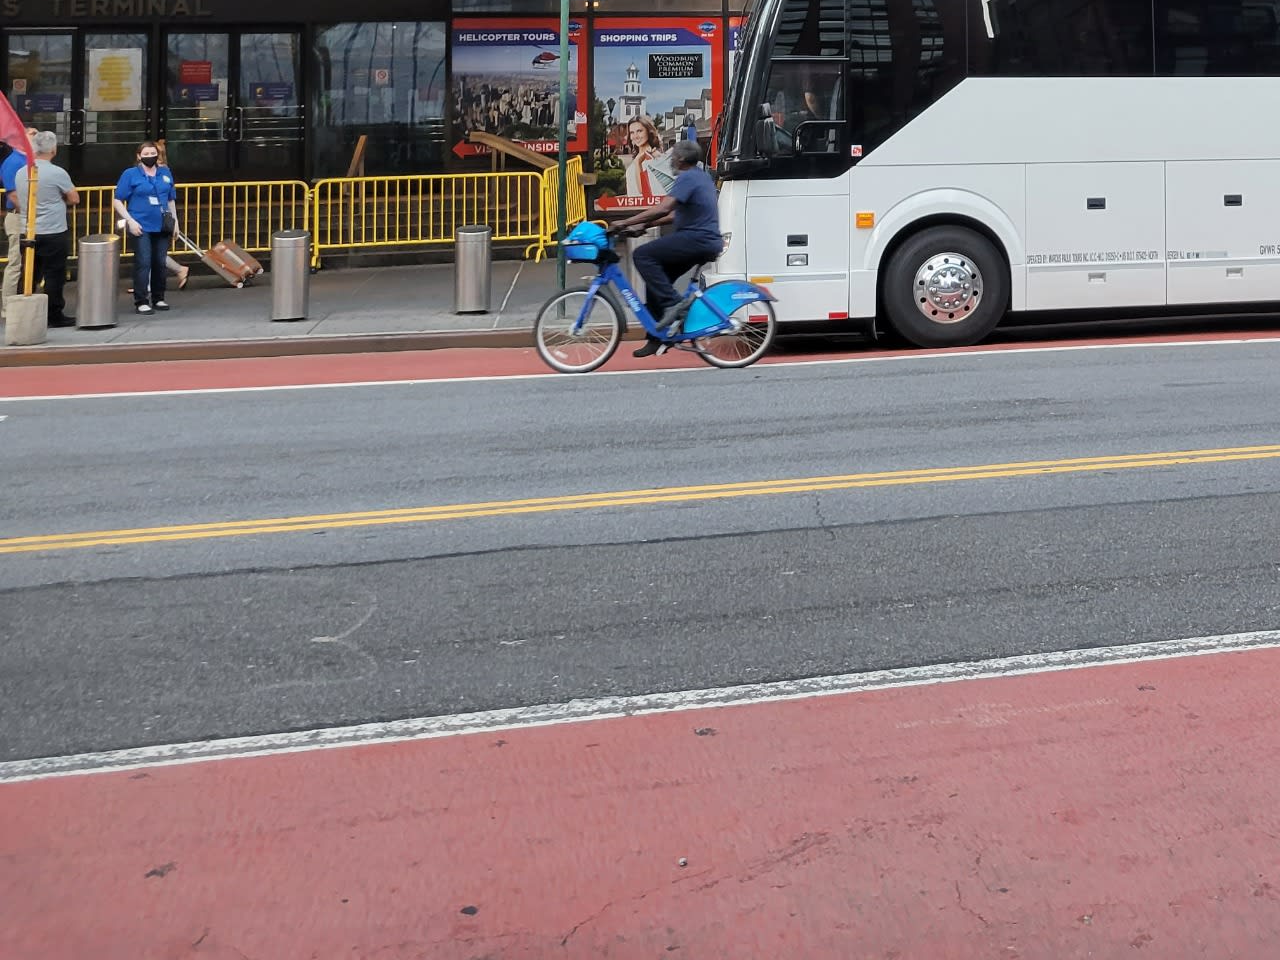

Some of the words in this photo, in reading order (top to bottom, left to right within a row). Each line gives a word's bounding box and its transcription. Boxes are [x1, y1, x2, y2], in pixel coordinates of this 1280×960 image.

[459, 33, 520, 42] HELICOPTER
[522, 33, 556, 41] TOURS
[600, 34, 649, 43] SHOPPING
[650, 33, 678, 42] TRIPS
[652, 55, 699, 63] WOODBURY
[616, 196, 645, 207] VISIT
[647, 196, 662, 206] US
[1259, 244, 1276, 255] GVWR
